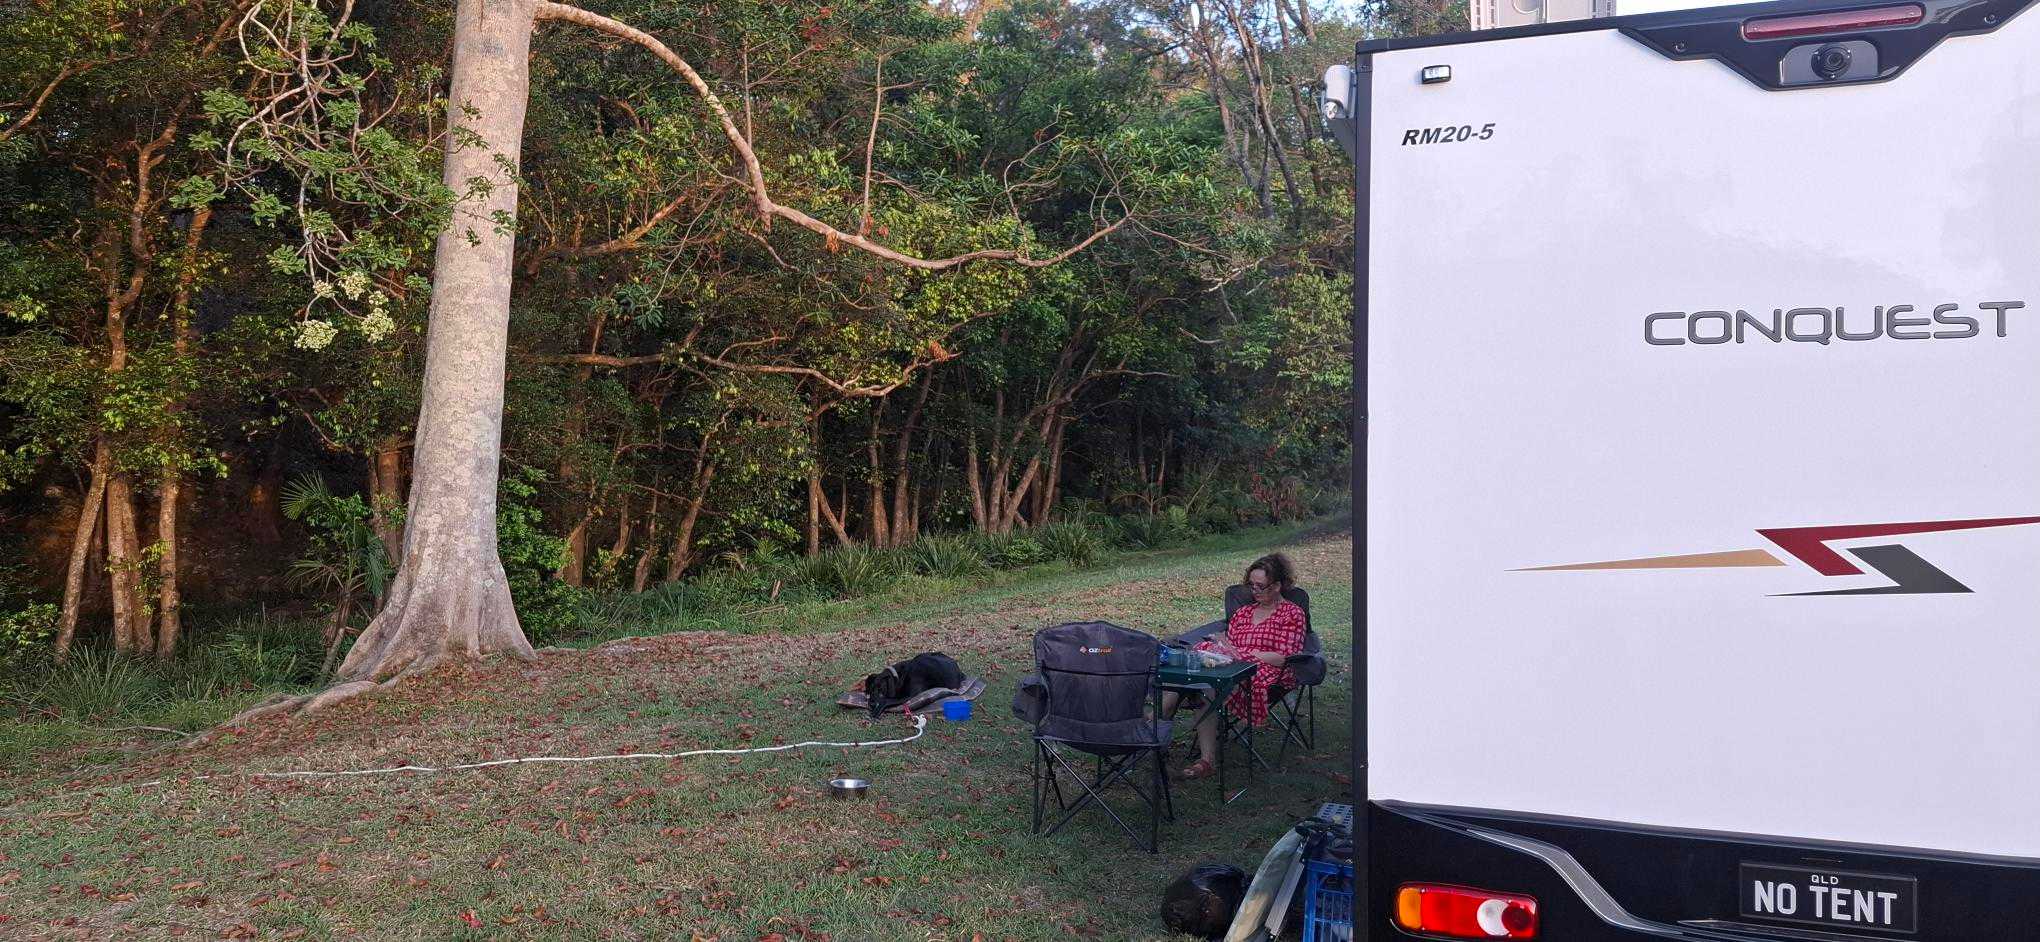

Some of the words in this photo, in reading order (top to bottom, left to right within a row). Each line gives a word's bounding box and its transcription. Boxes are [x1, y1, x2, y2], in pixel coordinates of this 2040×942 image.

[1402, 123, 1496, 146] RM20-5
[1644, 300, 2026, 346] CONQUEST
[1811, 874, 1839, 885] QLD
[1754, 880, 1797, 915] NO
[1809, 885, 1898, 925] TENT
